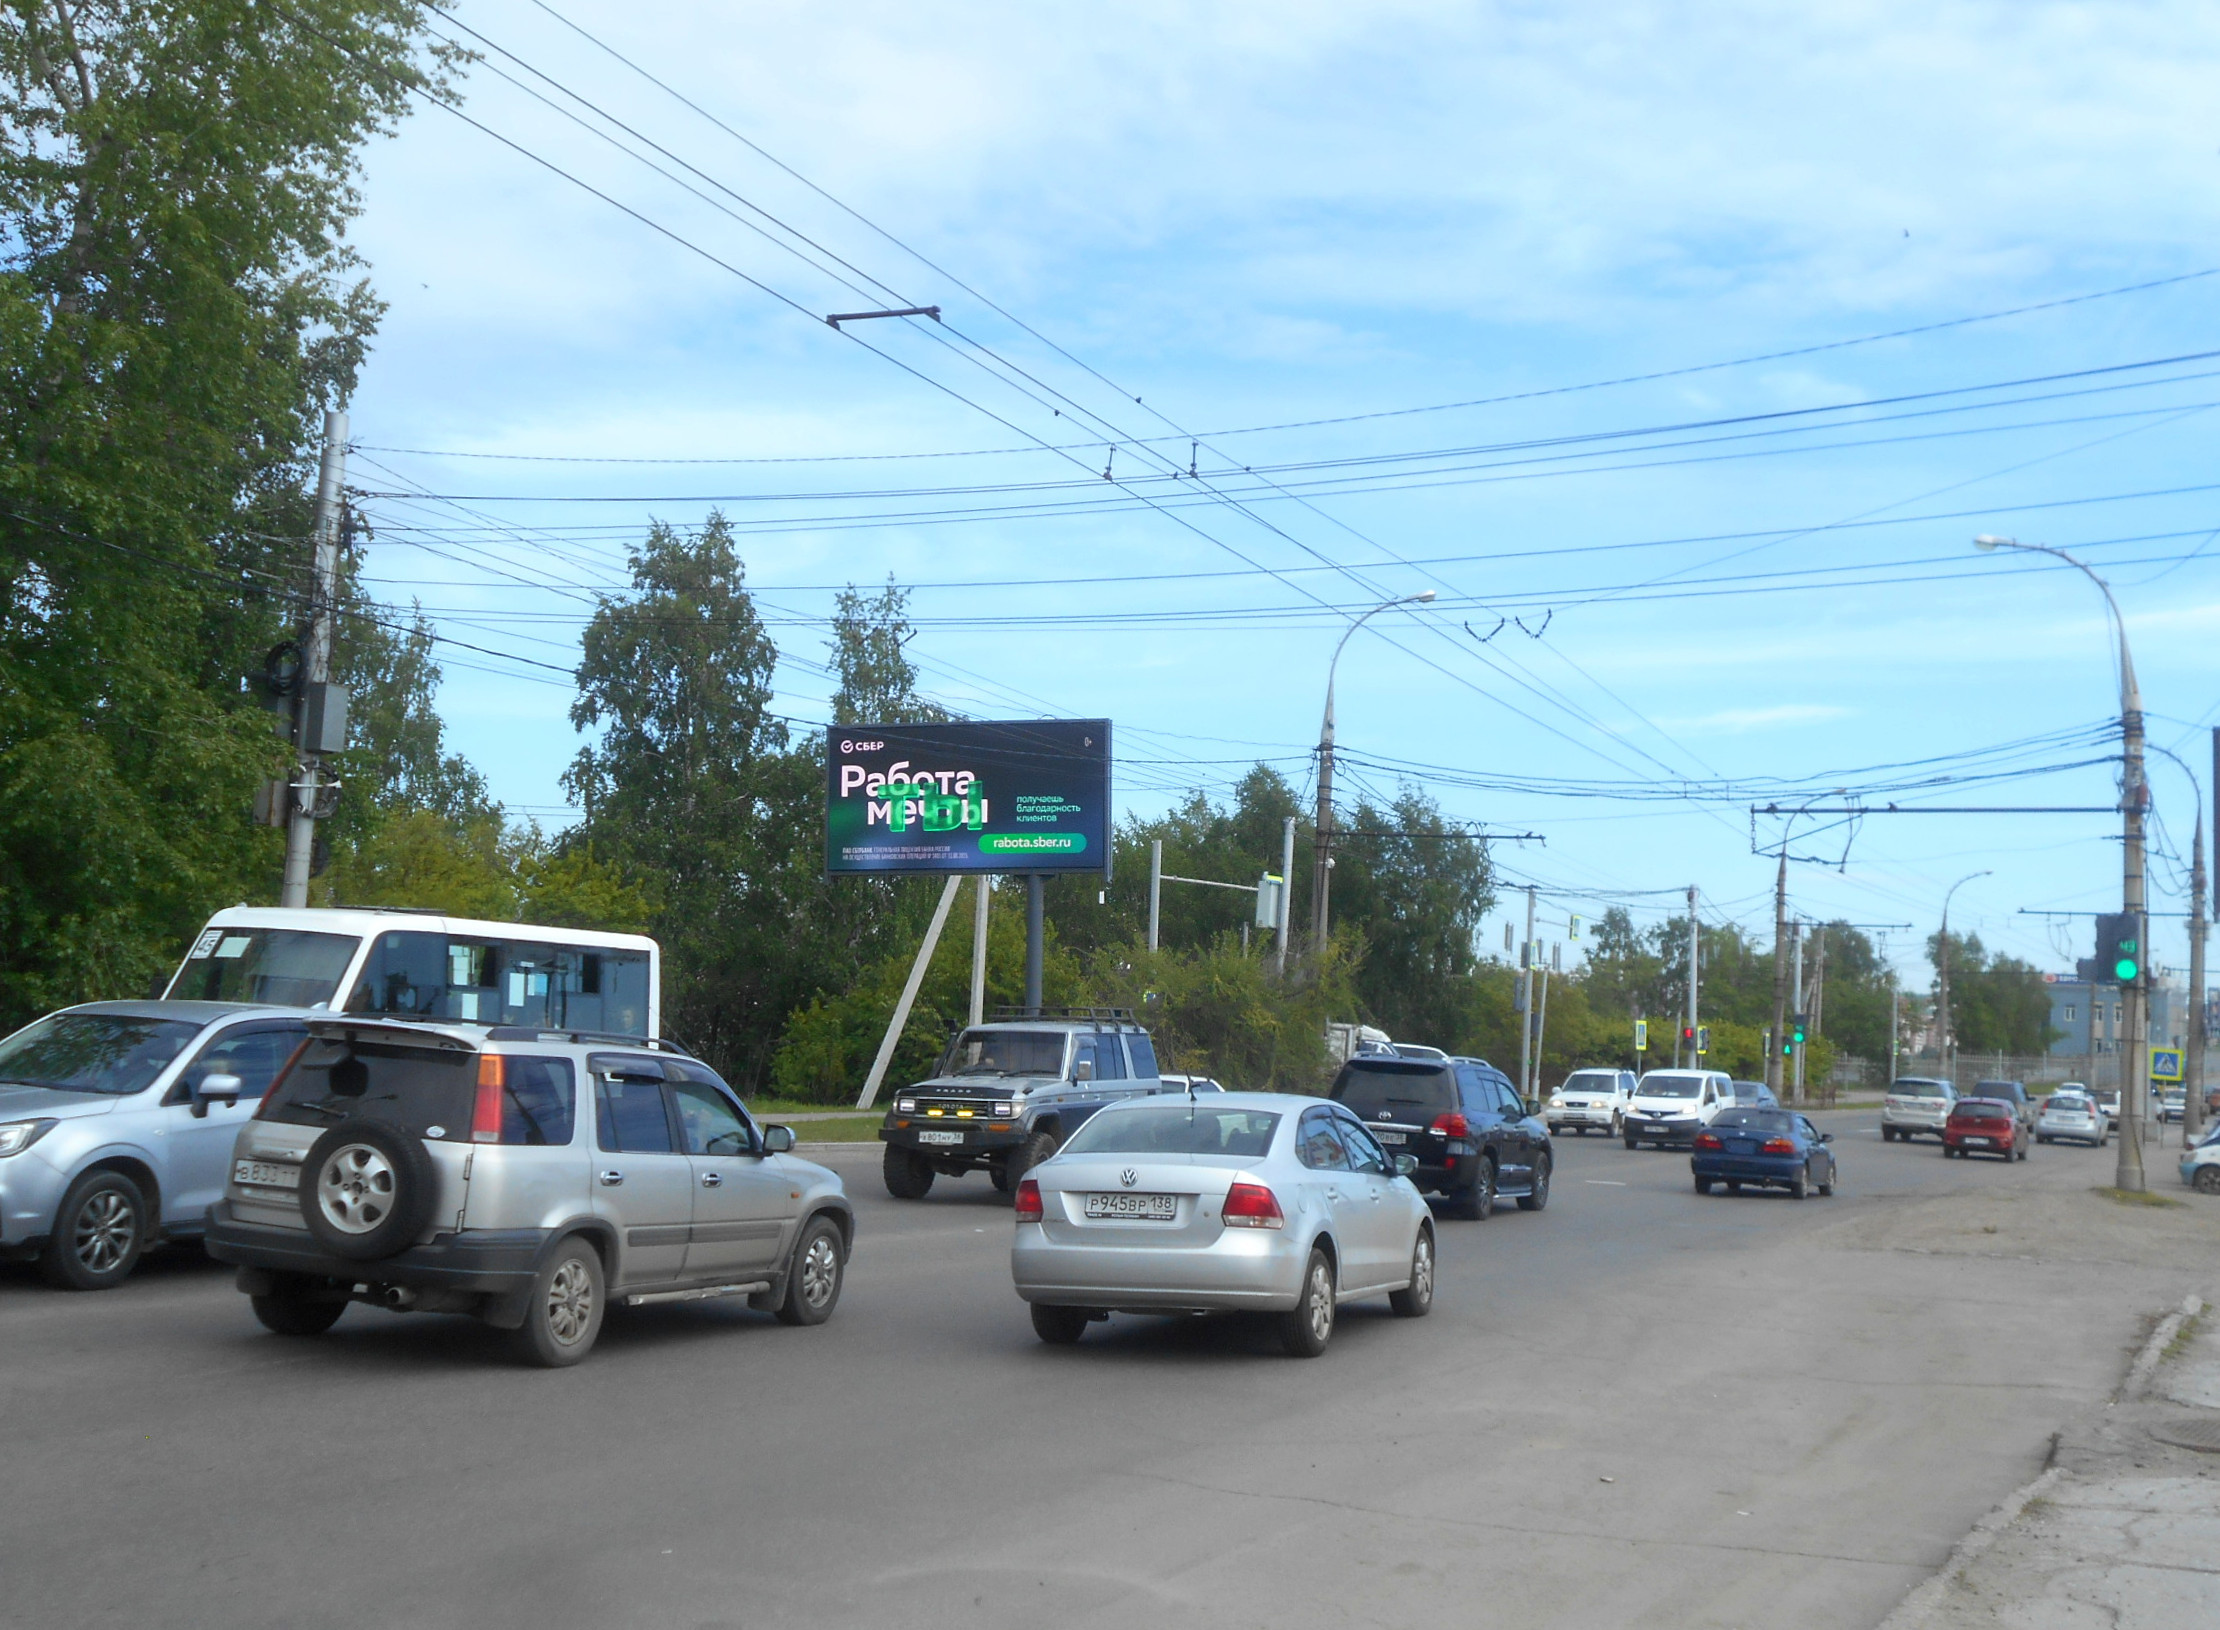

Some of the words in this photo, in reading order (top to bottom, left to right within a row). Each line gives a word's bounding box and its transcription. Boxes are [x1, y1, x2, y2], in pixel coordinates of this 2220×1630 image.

[855, 741, 884, 751] СБЕР
[841, 760, 976, 797] Работа
[1016, 795, 1064, 804] получаешь
[1016, 803, 1081, 813] благодарность
[993, 836, 1071, 848] rabota.sber.ru
[1150, 1196, 1171, 1208] 138
